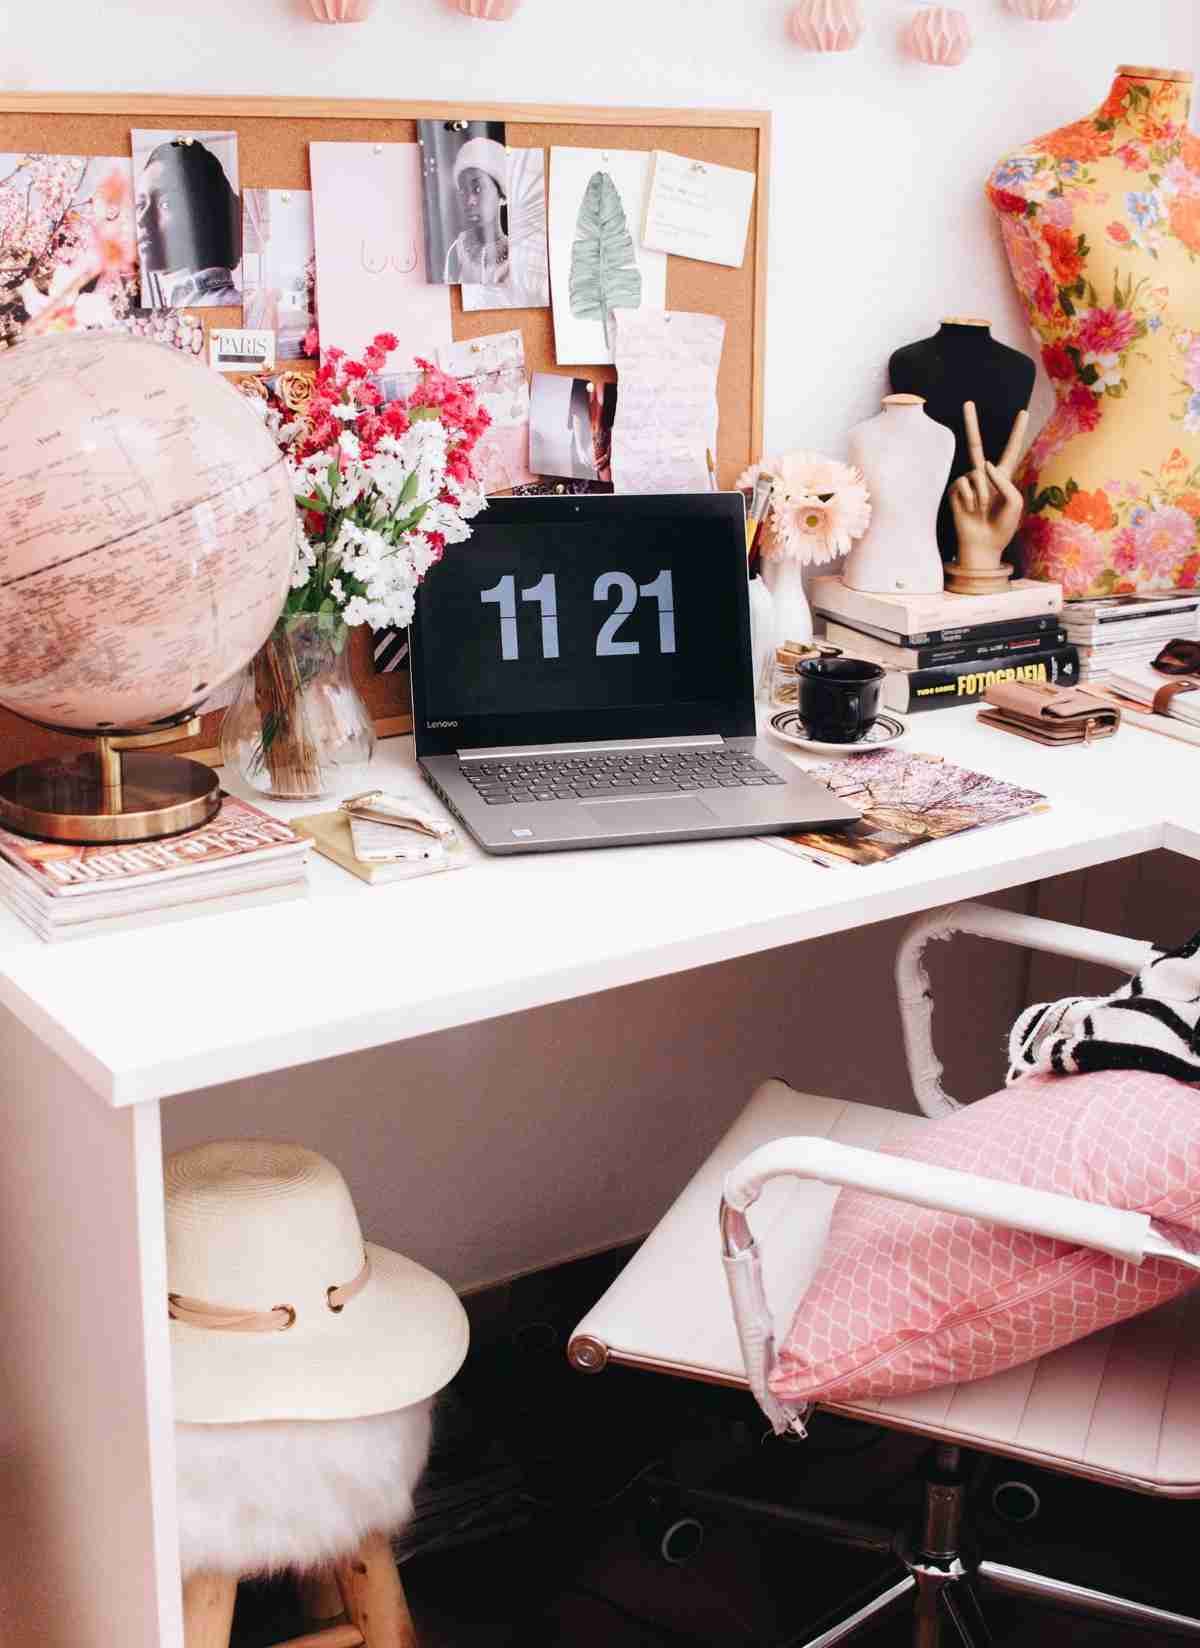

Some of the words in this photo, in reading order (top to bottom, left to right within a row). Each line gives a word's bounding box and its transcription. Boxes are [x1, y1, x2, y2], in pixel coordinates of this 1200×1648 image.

[217, 336, 267, 353] PARIS
[480, 573, 559, 660] 11
[592, 570, 676, 657] 21
[957, 663, 1048, 697] FOTOGRAFIA
[426, 720, 458, 729] Lenovo
